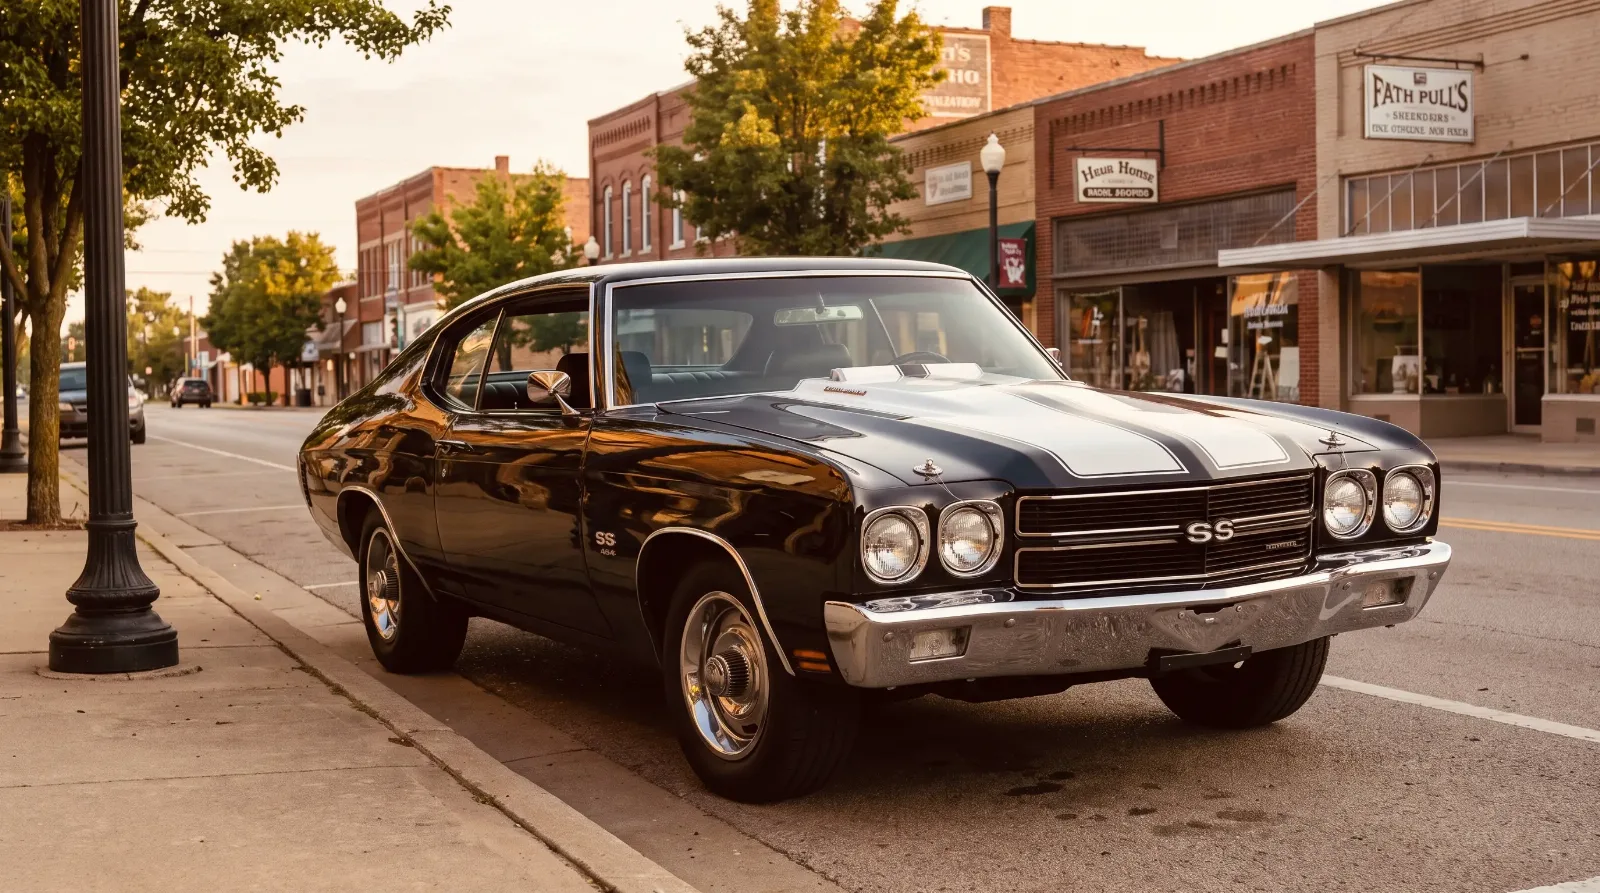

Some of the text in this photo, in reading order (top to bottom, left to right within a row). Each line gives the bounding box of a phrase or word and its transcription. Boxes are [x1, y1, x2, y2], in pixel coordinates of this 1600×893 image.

[1372, 73, 1469, 113] FATH PULL'S
[595, 531, 616, 547] SS
[1186, 520, 1235, 544] SS
